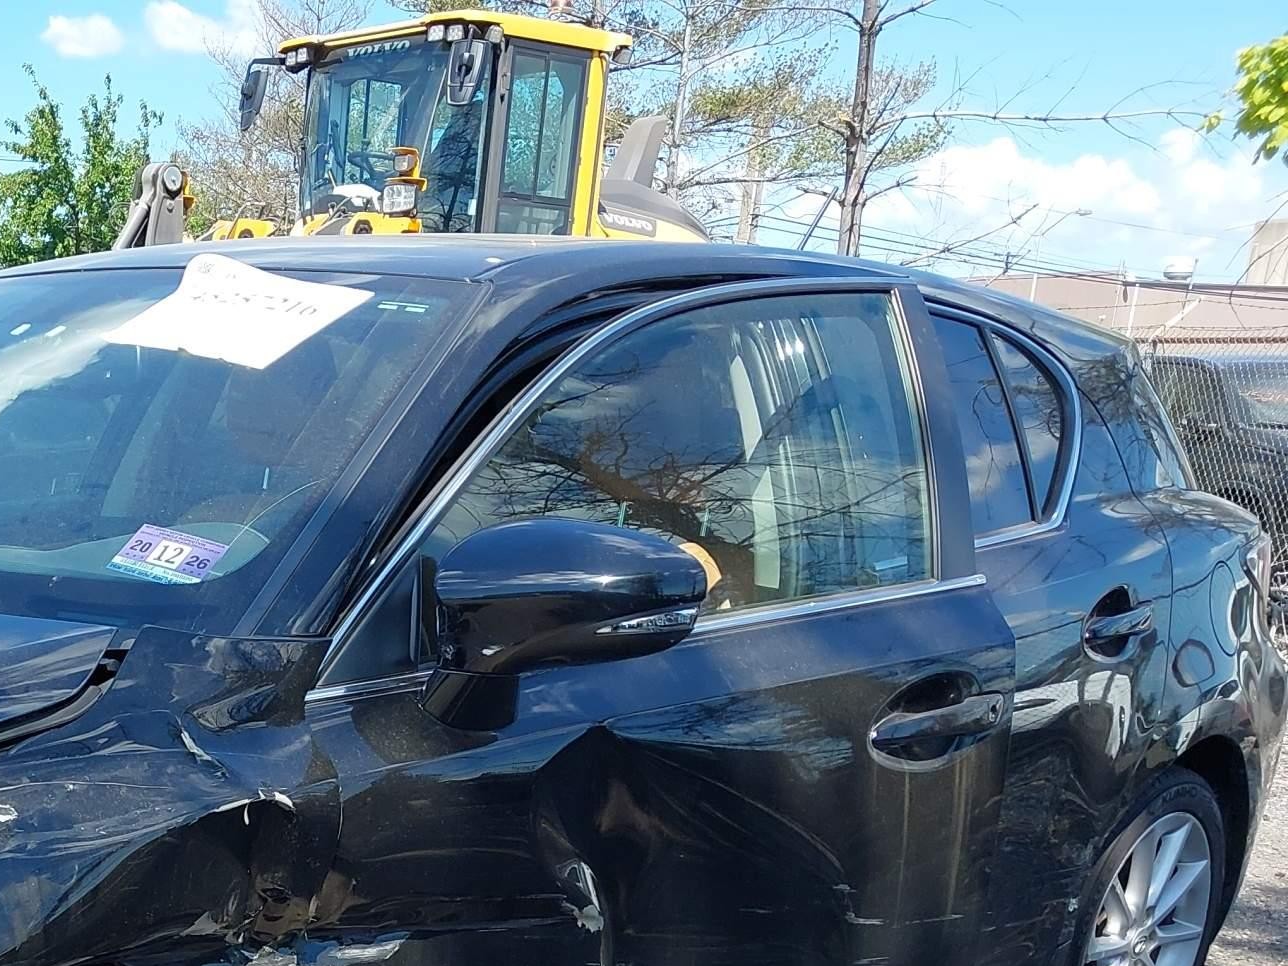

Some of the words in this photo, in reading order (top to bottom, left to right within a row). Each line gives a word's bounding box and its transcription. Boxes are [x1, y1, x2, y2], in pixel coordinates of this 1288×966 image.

[346, 39, 410, 57] VOLVO
[603, 211, 653, 232] VOLVO
[129, 539, 153, 553] 20
[152, 544, 185, 565] 12
[184, 555, 211, 570] 26
